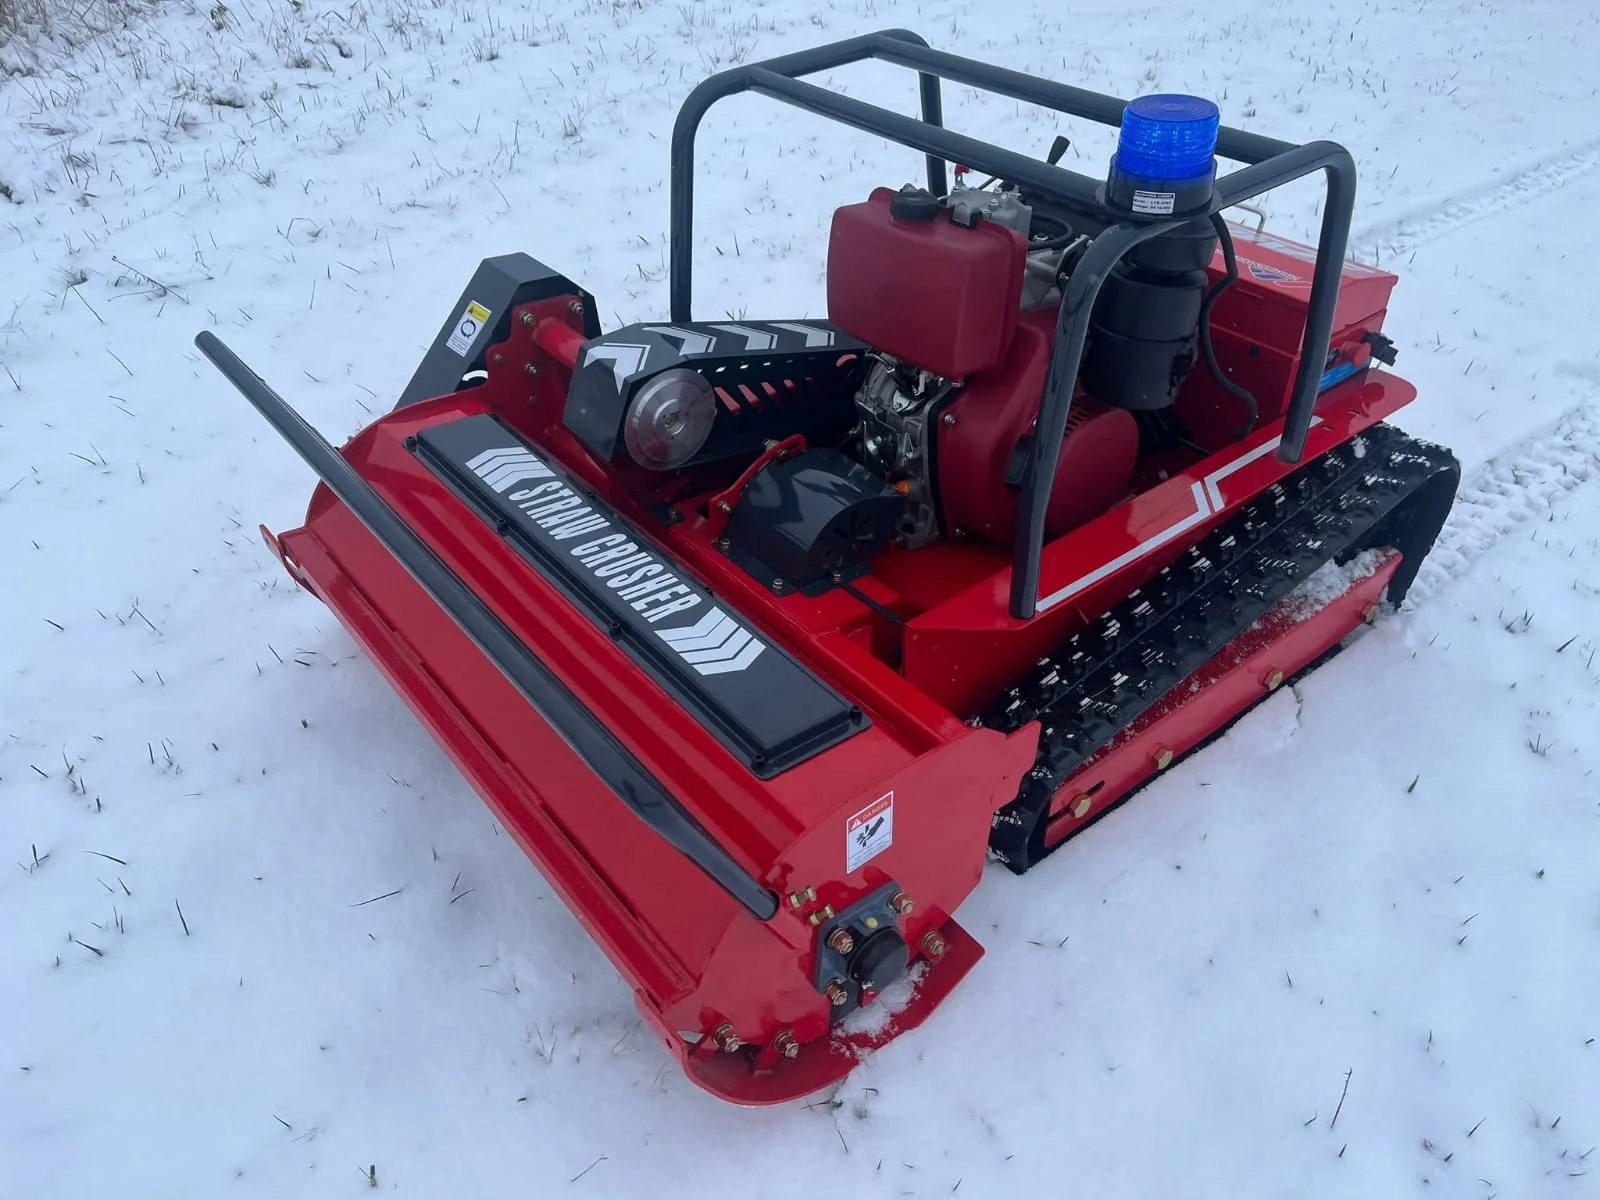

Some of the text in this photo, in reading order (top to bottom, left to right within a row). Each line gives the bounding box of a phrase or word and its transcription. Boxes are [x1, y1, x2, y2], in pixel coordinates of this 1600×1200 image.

[508, 481, 702, 623] STRAW CRUSHER
[862, 800, 889, 821] DANGER
